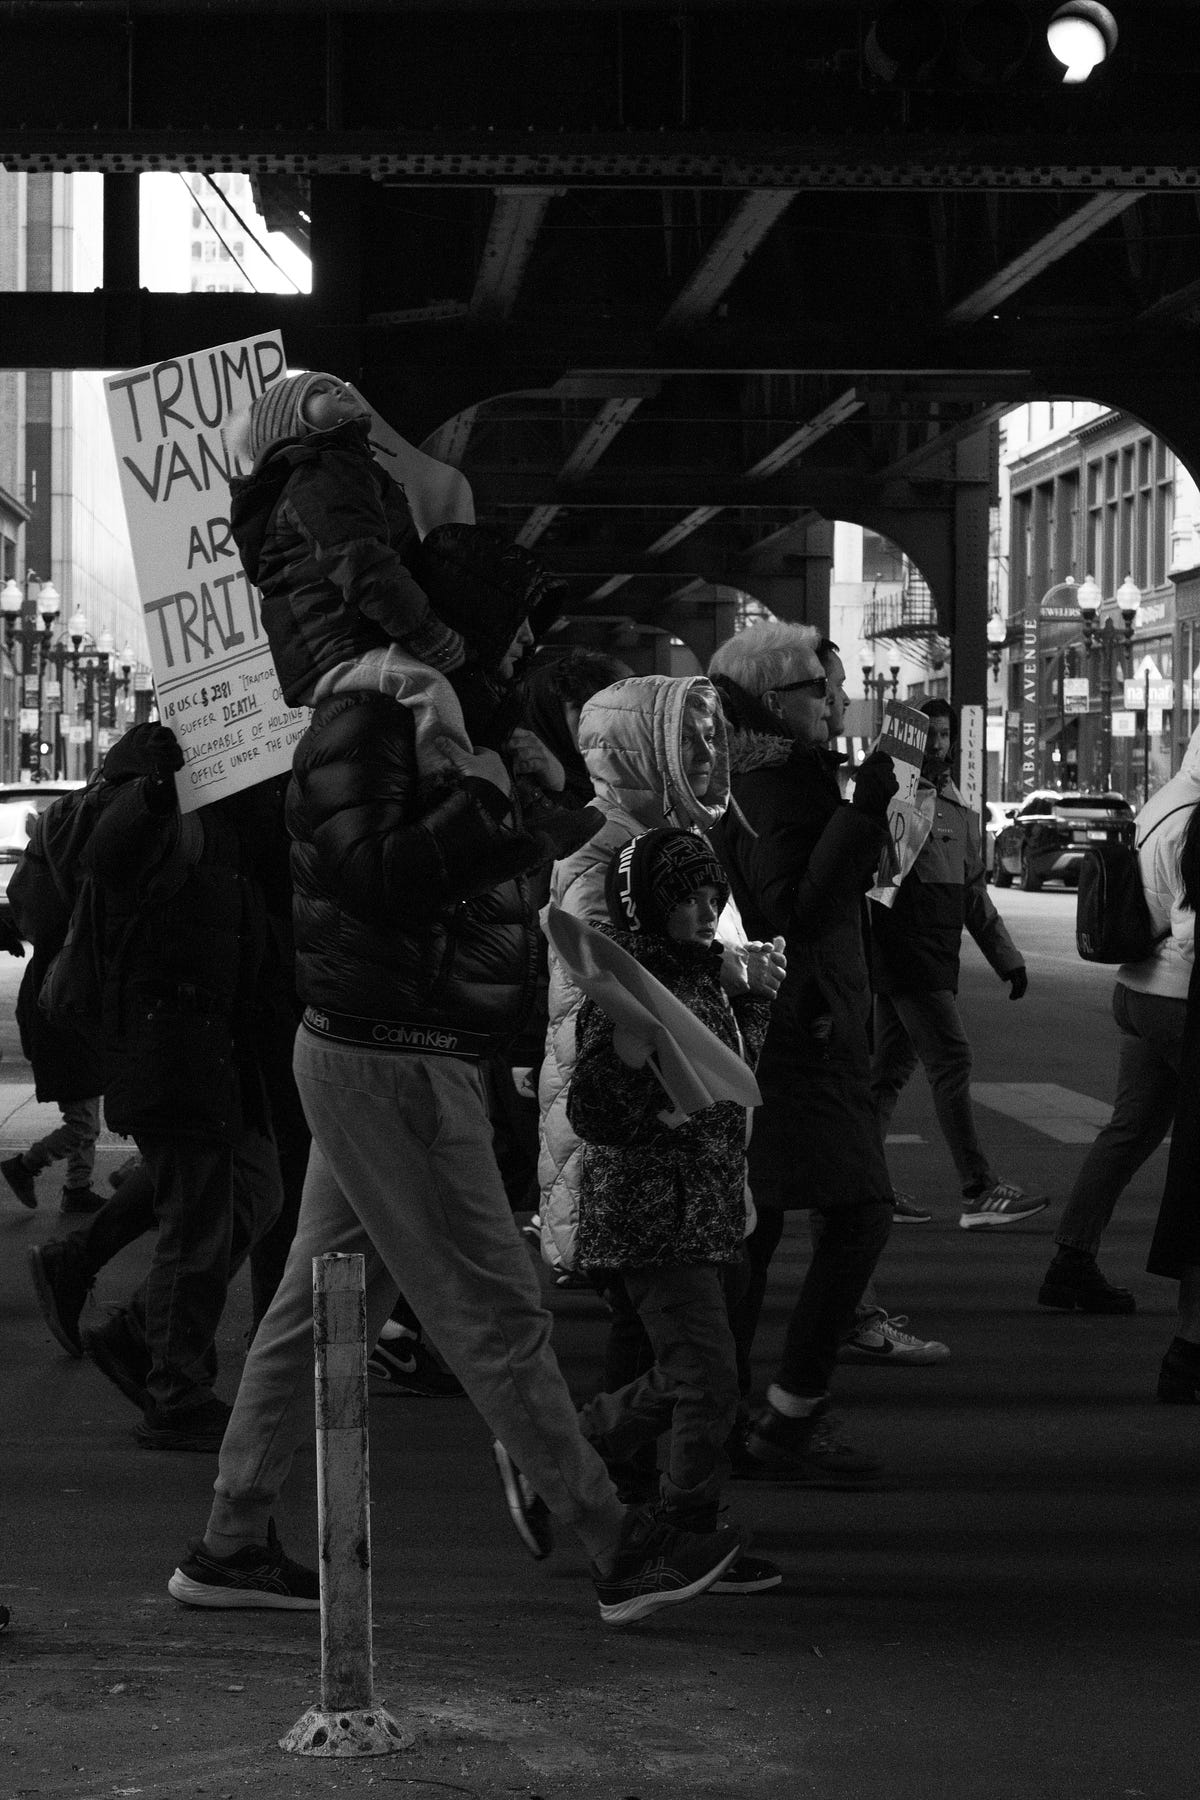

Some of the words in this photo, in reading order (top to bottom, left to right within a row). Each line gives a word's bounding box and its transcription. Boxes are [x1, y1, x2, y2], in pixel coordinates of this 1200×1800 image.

[108, 340, 285, 443] TRUMP
[121, 432, 245, 503] VAN
[143, 570, 264, 669] TRAIT
[1023, 618, 1037, 704] AVENUE
[164, 702, 176, 720] 18
[211, 680, 232, 703] 2381
[180, 712, 217, 736] SUFFER
[222, 693, 258, 722] DEATH
[183, 728, 245, 763] INCAPABLE
[252, 722, 264, 737] OF
[268, 708, 303, 729] HOLDING
[190, 759, 226, 785] OFFICE
[230, 746, 261, 768] UNDER
[265, 737, 283, 752] THE
